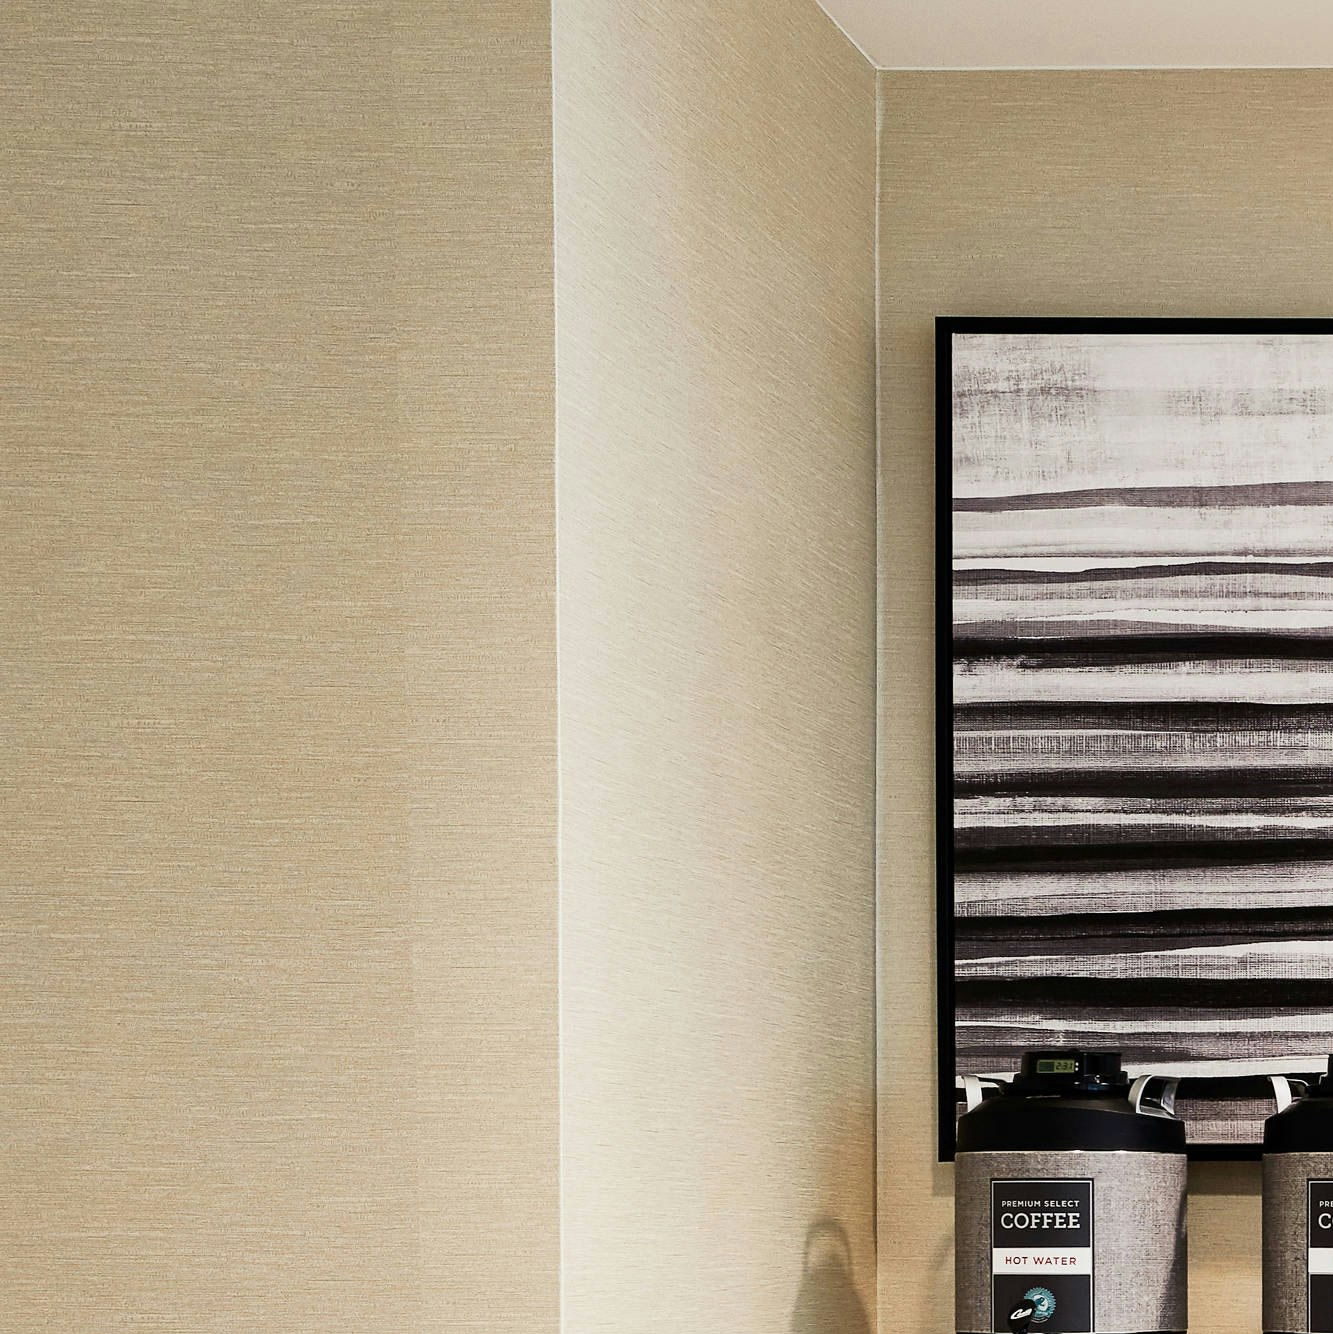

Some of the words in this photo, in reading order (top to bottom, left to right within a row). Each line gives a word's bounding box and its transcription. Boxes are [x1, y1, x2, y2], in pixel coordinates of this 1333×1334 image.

[1002, 1200, 1041, 1208] PREMIUM
[1044, 1200, 1080, 1208] SELECT
[1000, 1212, 1081, 1229] COFFEE
[1005, 1256, 1028, 1265] HOT
[1033, 1256, 1077, 1266] WATER
